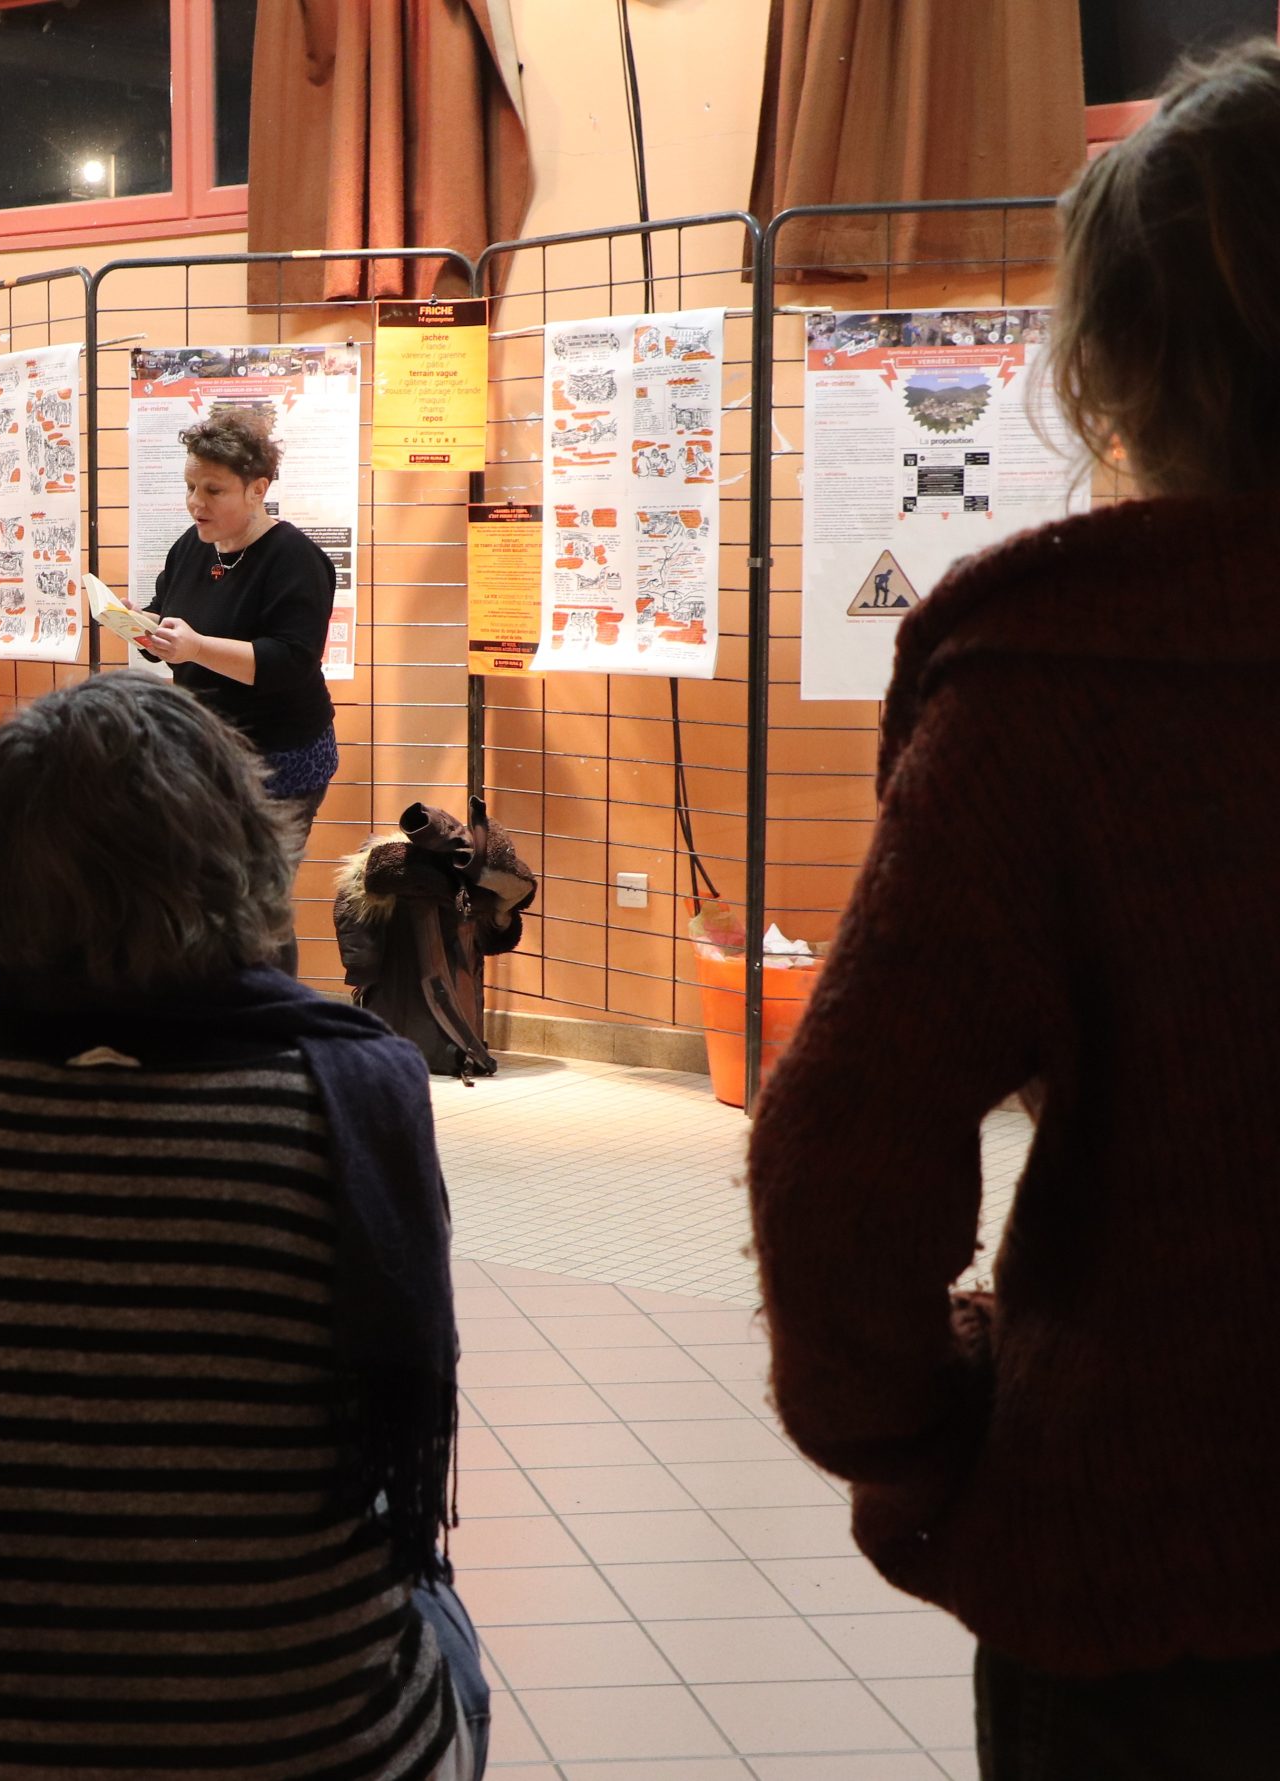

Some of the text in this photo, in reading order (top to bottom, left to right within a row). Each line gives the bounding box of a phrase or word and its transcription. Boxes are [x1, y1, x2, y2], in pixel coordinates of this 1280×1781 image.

[419, 305, 454, 315] FRICHE
[421, 333, 449, 342] jachère
[409, 369, 458, 378] terrain vague
[422, 415, 443, 423] repos
[930, 436, 975, 446] proposition
